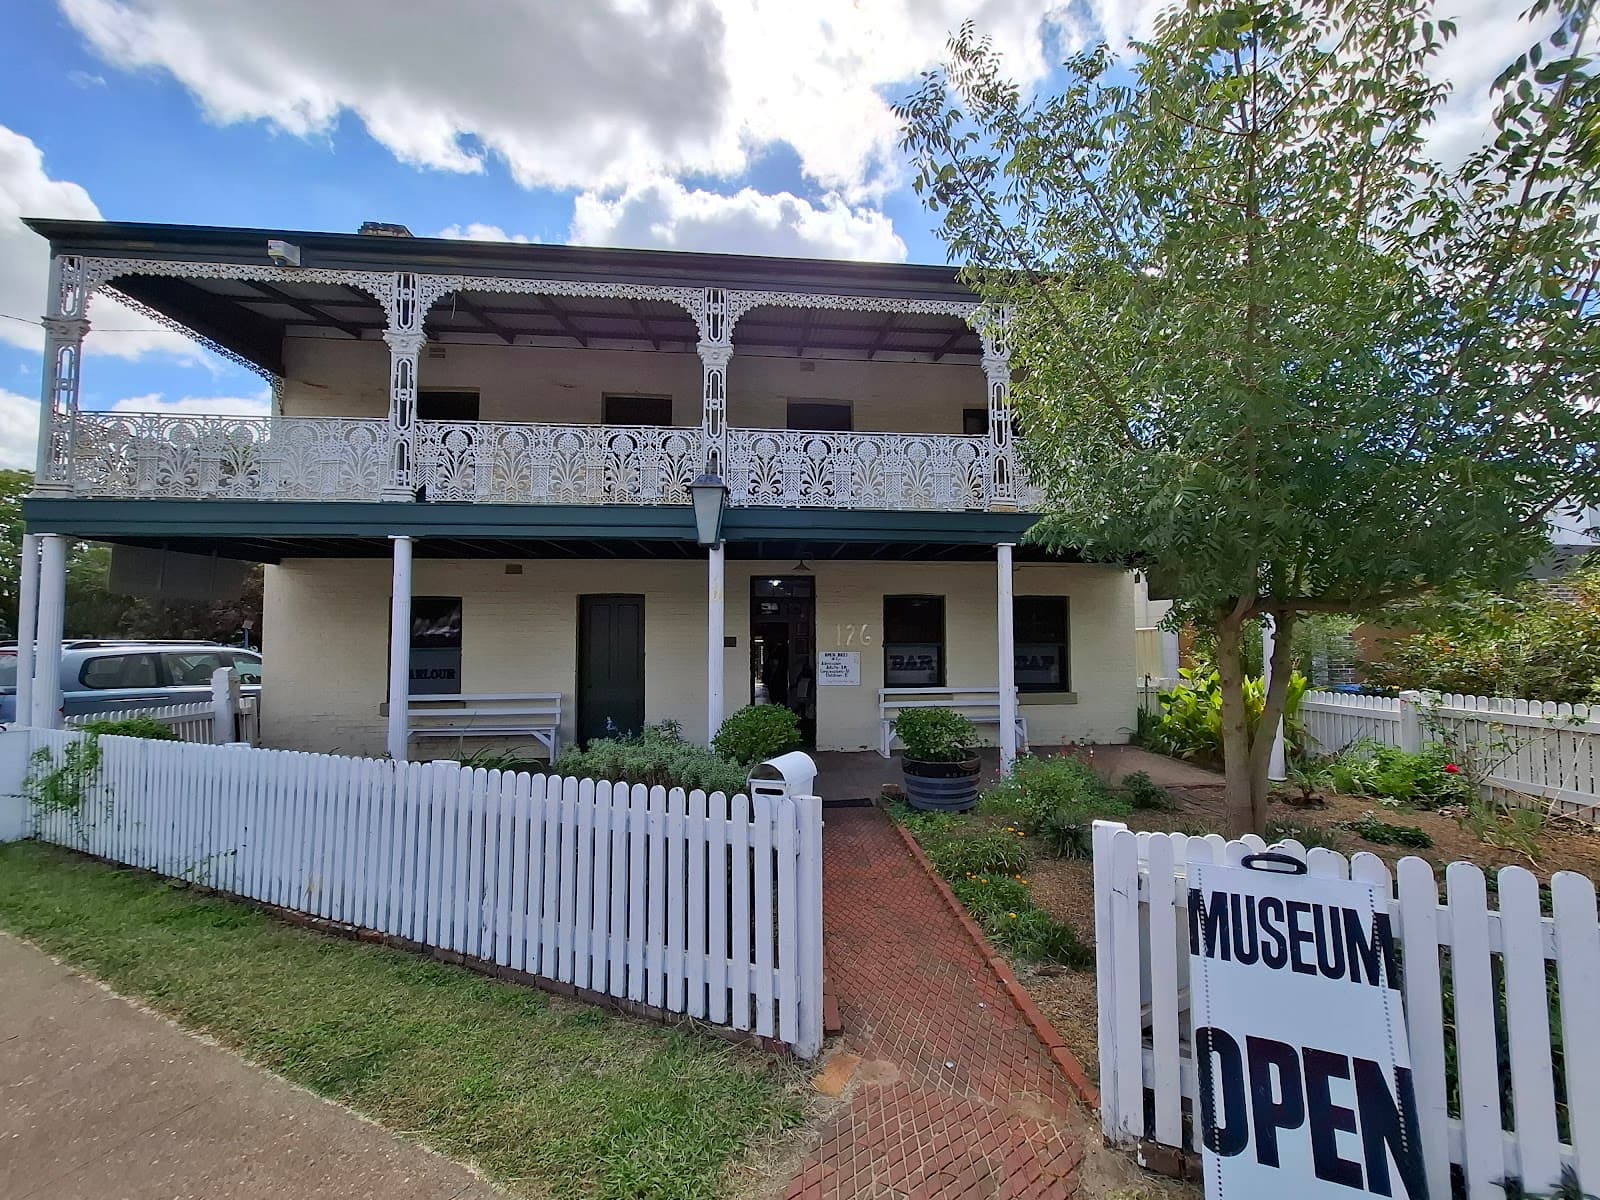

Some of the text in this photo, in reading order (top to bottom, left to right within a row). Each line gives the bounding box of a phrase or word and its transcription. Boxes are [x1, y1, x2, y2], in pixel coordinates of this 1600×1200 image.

[409, 668, 457, 680] ARLOUR
[889, 655, 935, 671] BAR
[1188, 888, 1402, 991] MUSEUM
[1195, 1026, 1430, 1200] OPEN
